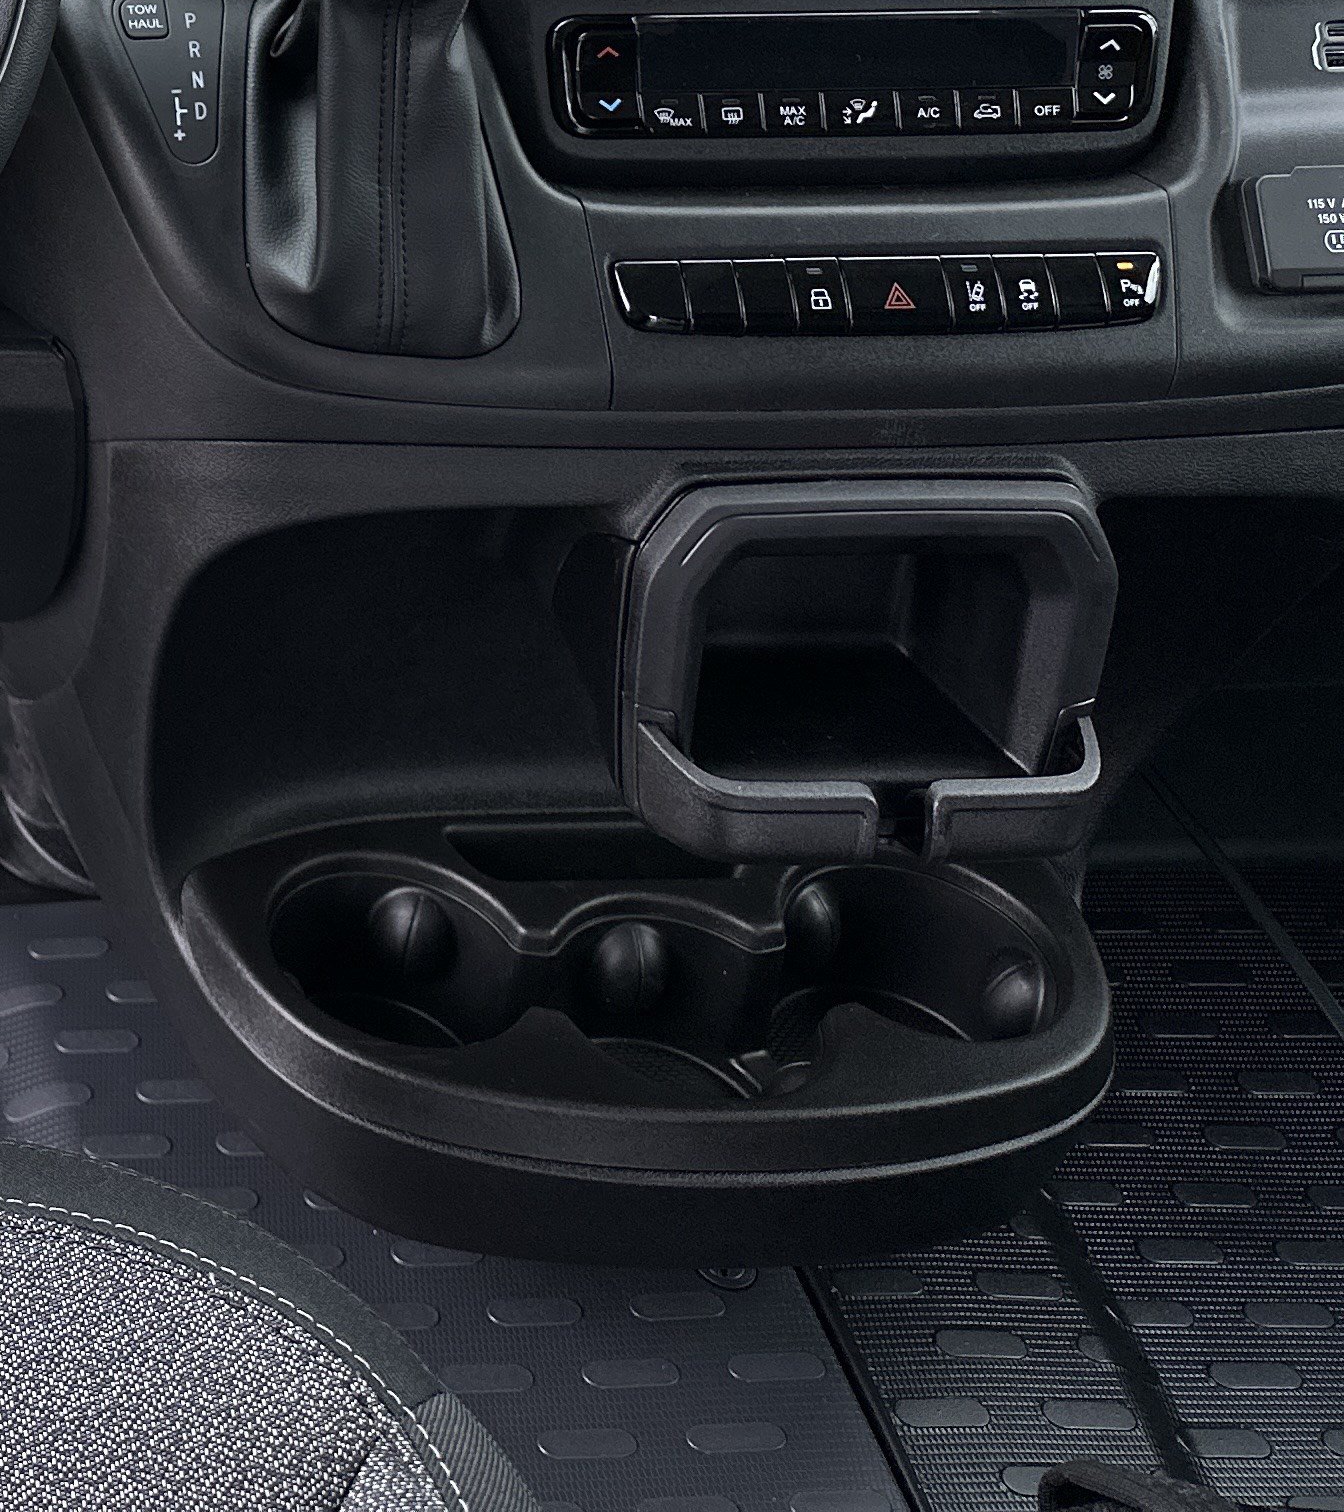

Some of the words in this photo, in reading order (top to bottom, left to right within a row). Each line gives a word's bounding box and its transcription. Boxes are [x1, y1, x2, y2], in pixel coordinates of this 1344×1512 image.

[126, 4, 158, 15] TOW
[128, 18, 163, 29] HAUL
[184, 12, 197, 29] P
[188, 41, 201, 58] R
[191, 70, 205, 89] N
[194, 101, 207, 120] D
[779, 106, 807, 115] MAX
[917, 107, 940, 118] A/C
[1034, 105, 1061, 117] OFF
[669, 117, 693, 127] MAX
[783, 116, 806, 126] A/C
[1307, 198, 1326, 209] 115
[1326, 198, 1336, 209] V
[1317, 213, 1338, 224] 150
[969, 303, 986, 312] OFF
[1021, 302, 1039, 311] OFF
[1123, 299, 1140, 308] OFF
